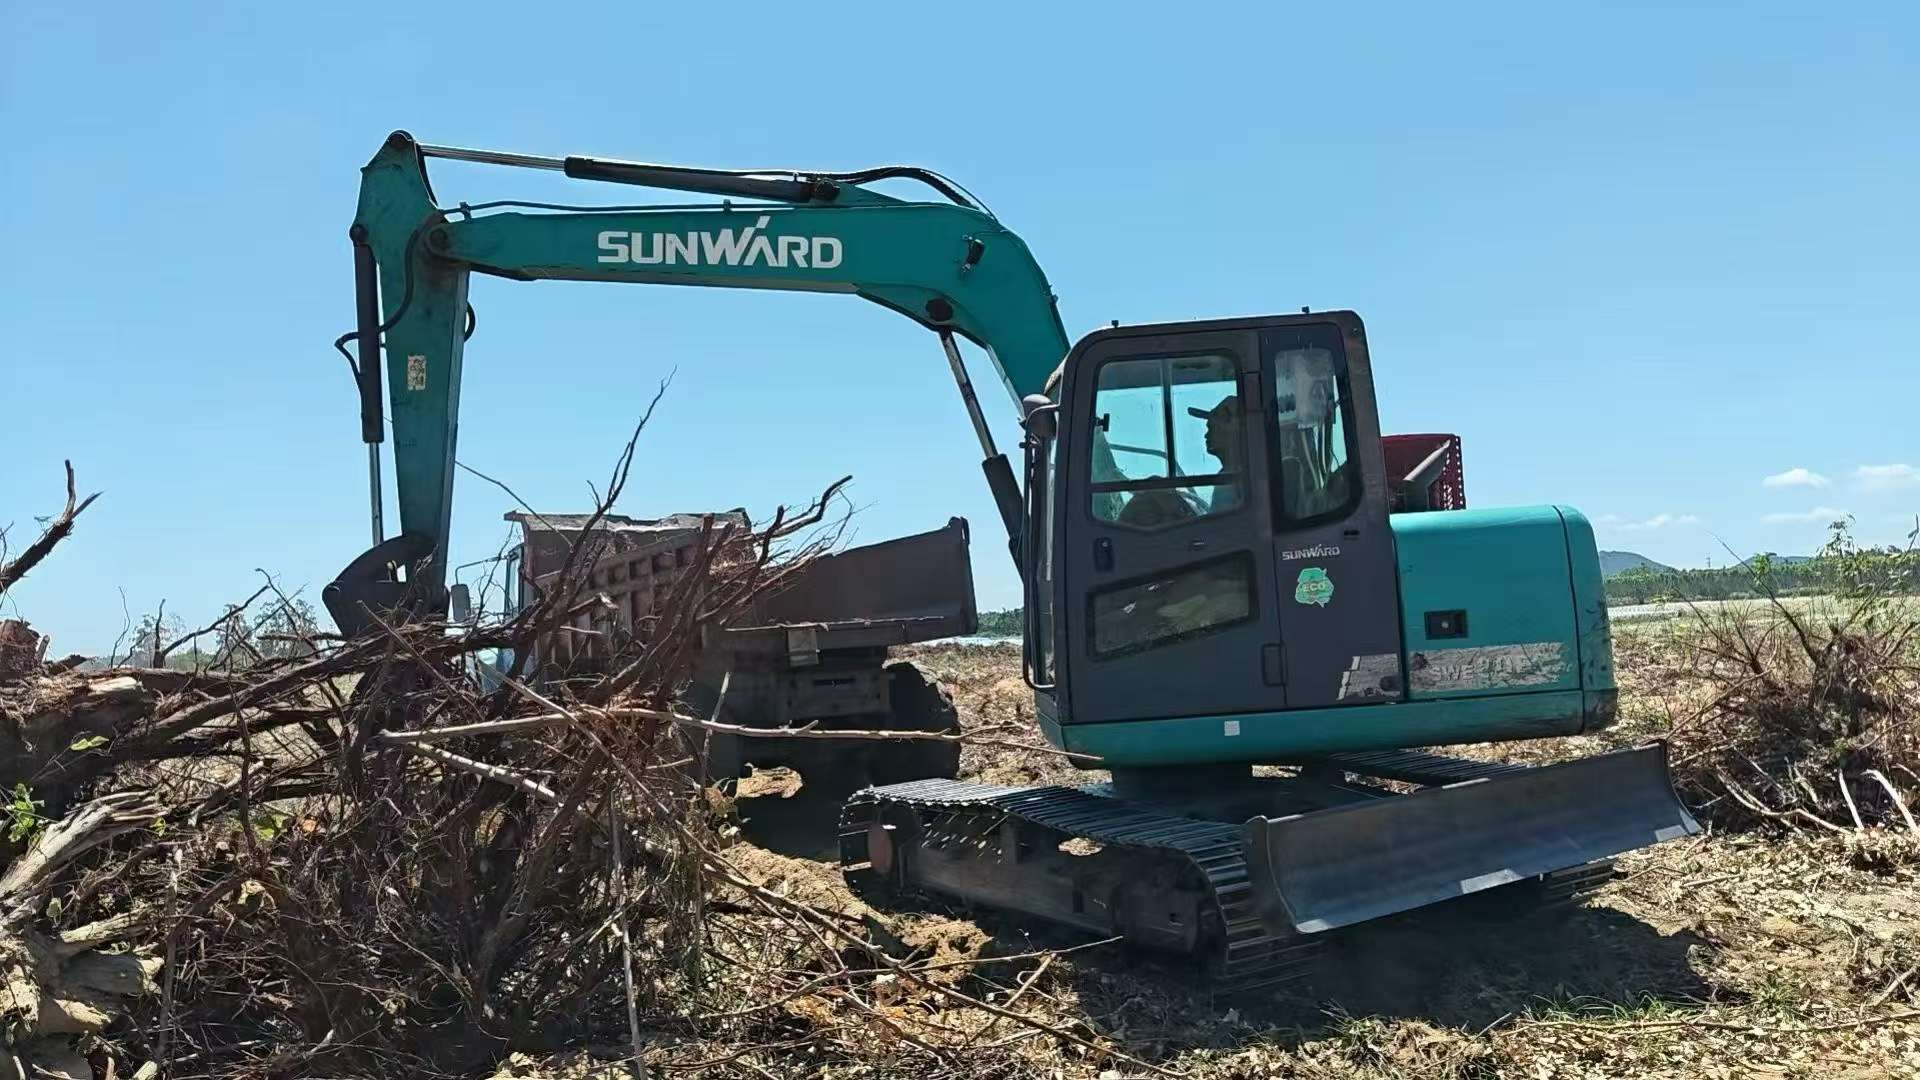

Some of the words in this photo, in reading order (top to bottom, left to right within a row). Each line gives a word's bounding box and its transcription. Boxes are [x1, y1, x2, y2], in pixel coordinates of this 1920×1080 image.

[597, 215, 843, 269] SUNWARD
[1282, 543, 1340, 560] SUNWARD
[1303, 582, 1326, 592] ECO
